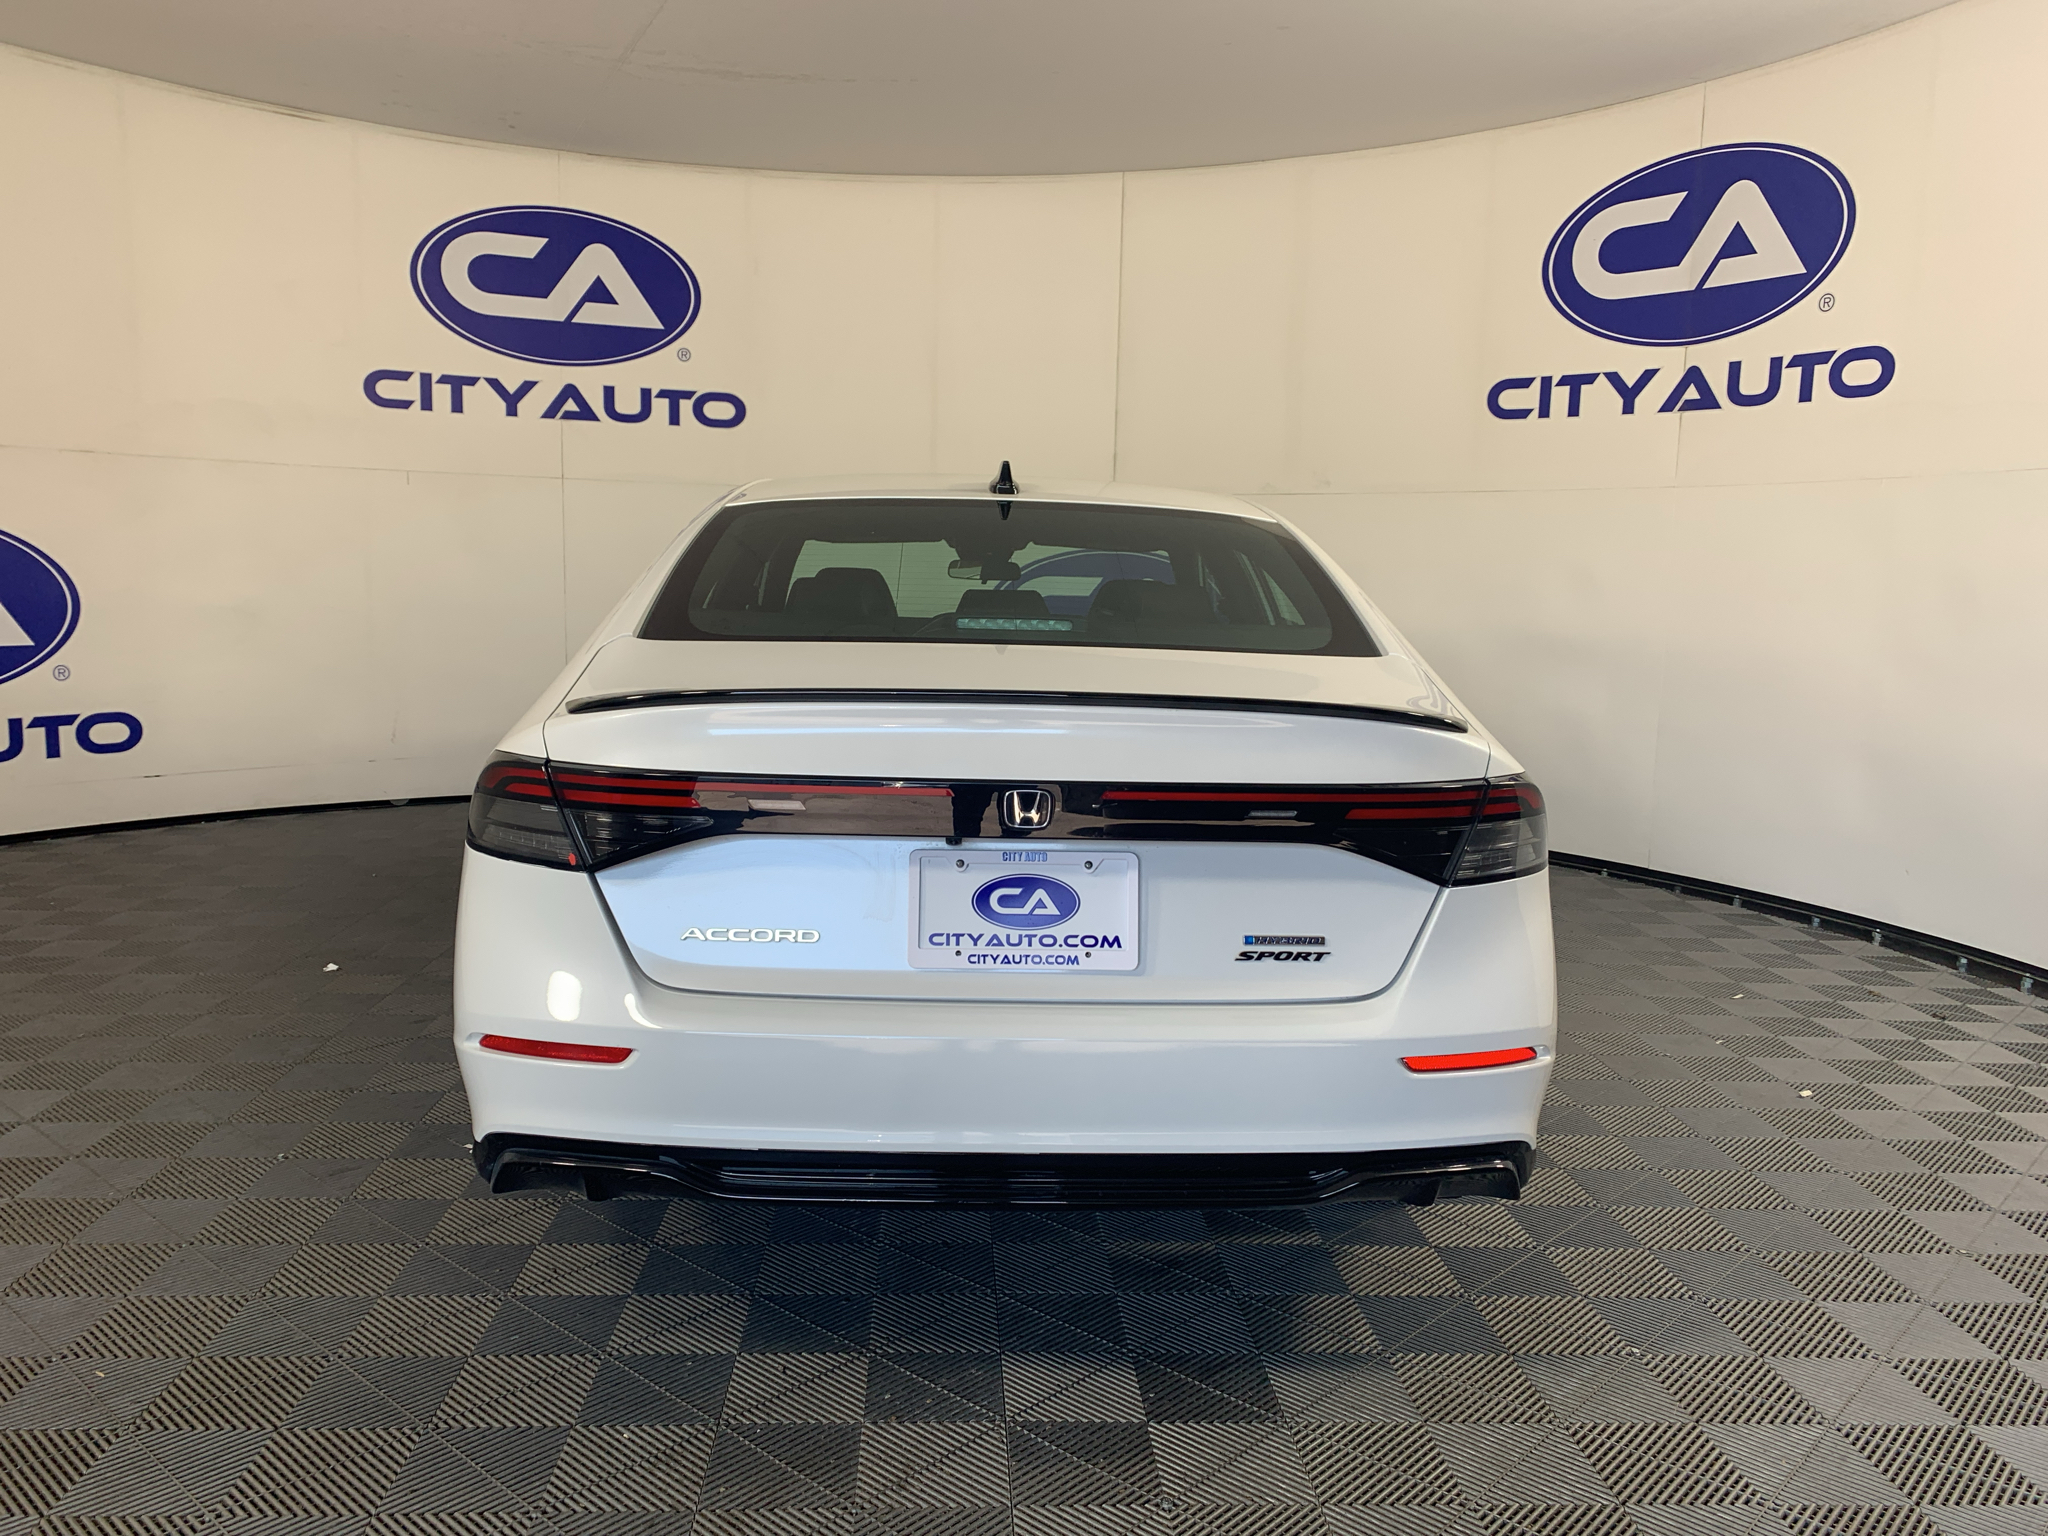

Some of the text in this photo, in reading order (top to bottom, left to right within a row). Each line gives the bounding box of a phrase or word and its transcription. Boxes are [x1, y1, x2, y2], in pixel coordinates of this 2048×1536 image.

[1571, 179, 1808, 300] CA
[440, 231, 665, 330] CA
[1002, 852, 1047, 862] CITY AUTO
[989, 887, 1061, 915] CA
[680, 927, 821, 943] ACCORD
[928, 933, 1122, 949] CITYAUTO.COM
[967, 954, 1080, 965] CITYAUTO.COM
[1234, 951, 1331, 961] SPORT
